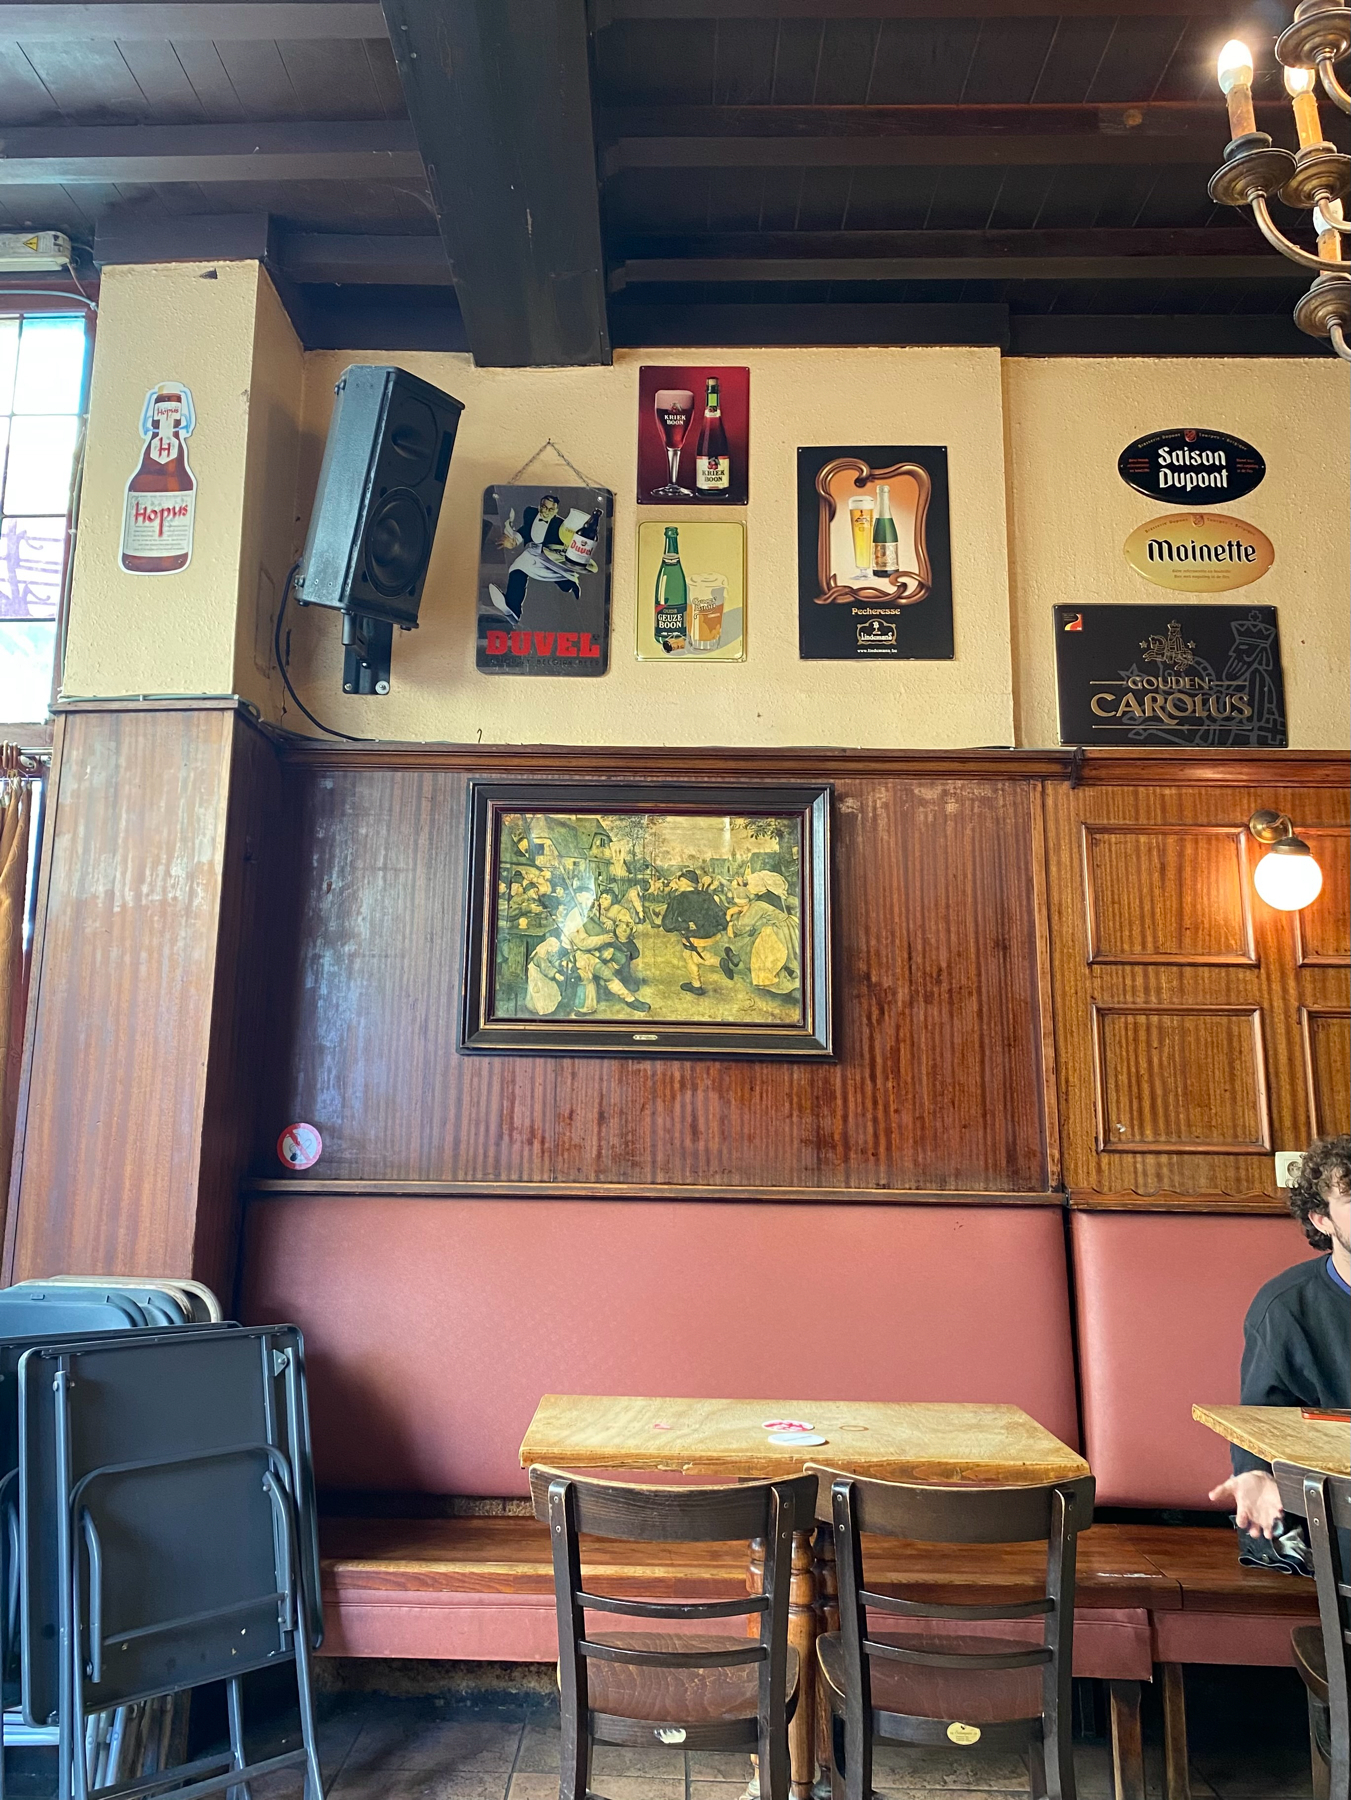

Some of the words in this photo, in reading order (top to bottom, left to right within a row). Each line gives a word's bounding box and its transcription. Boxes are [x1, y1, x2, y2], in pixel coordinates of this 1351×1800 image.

[157, 407, 179, 421] Hopus
[1157, 446, 1227, 466] Saison
[704, 475, 723, 483] BOON
[1158, 468, 1229, 492] Dupont
[133, 500, 189, 538] Hopus
[570, 539, 593, 556] Duvel
[1147, 538, 1257, 563] Moinette
[851, 607, 901, 615] Pecheresse
[485, 630, 600, 657] DUVEL
[1128, 676, 1211, 690] GOUDEN
[1090, 692, 1253, 725] CAROLUS
